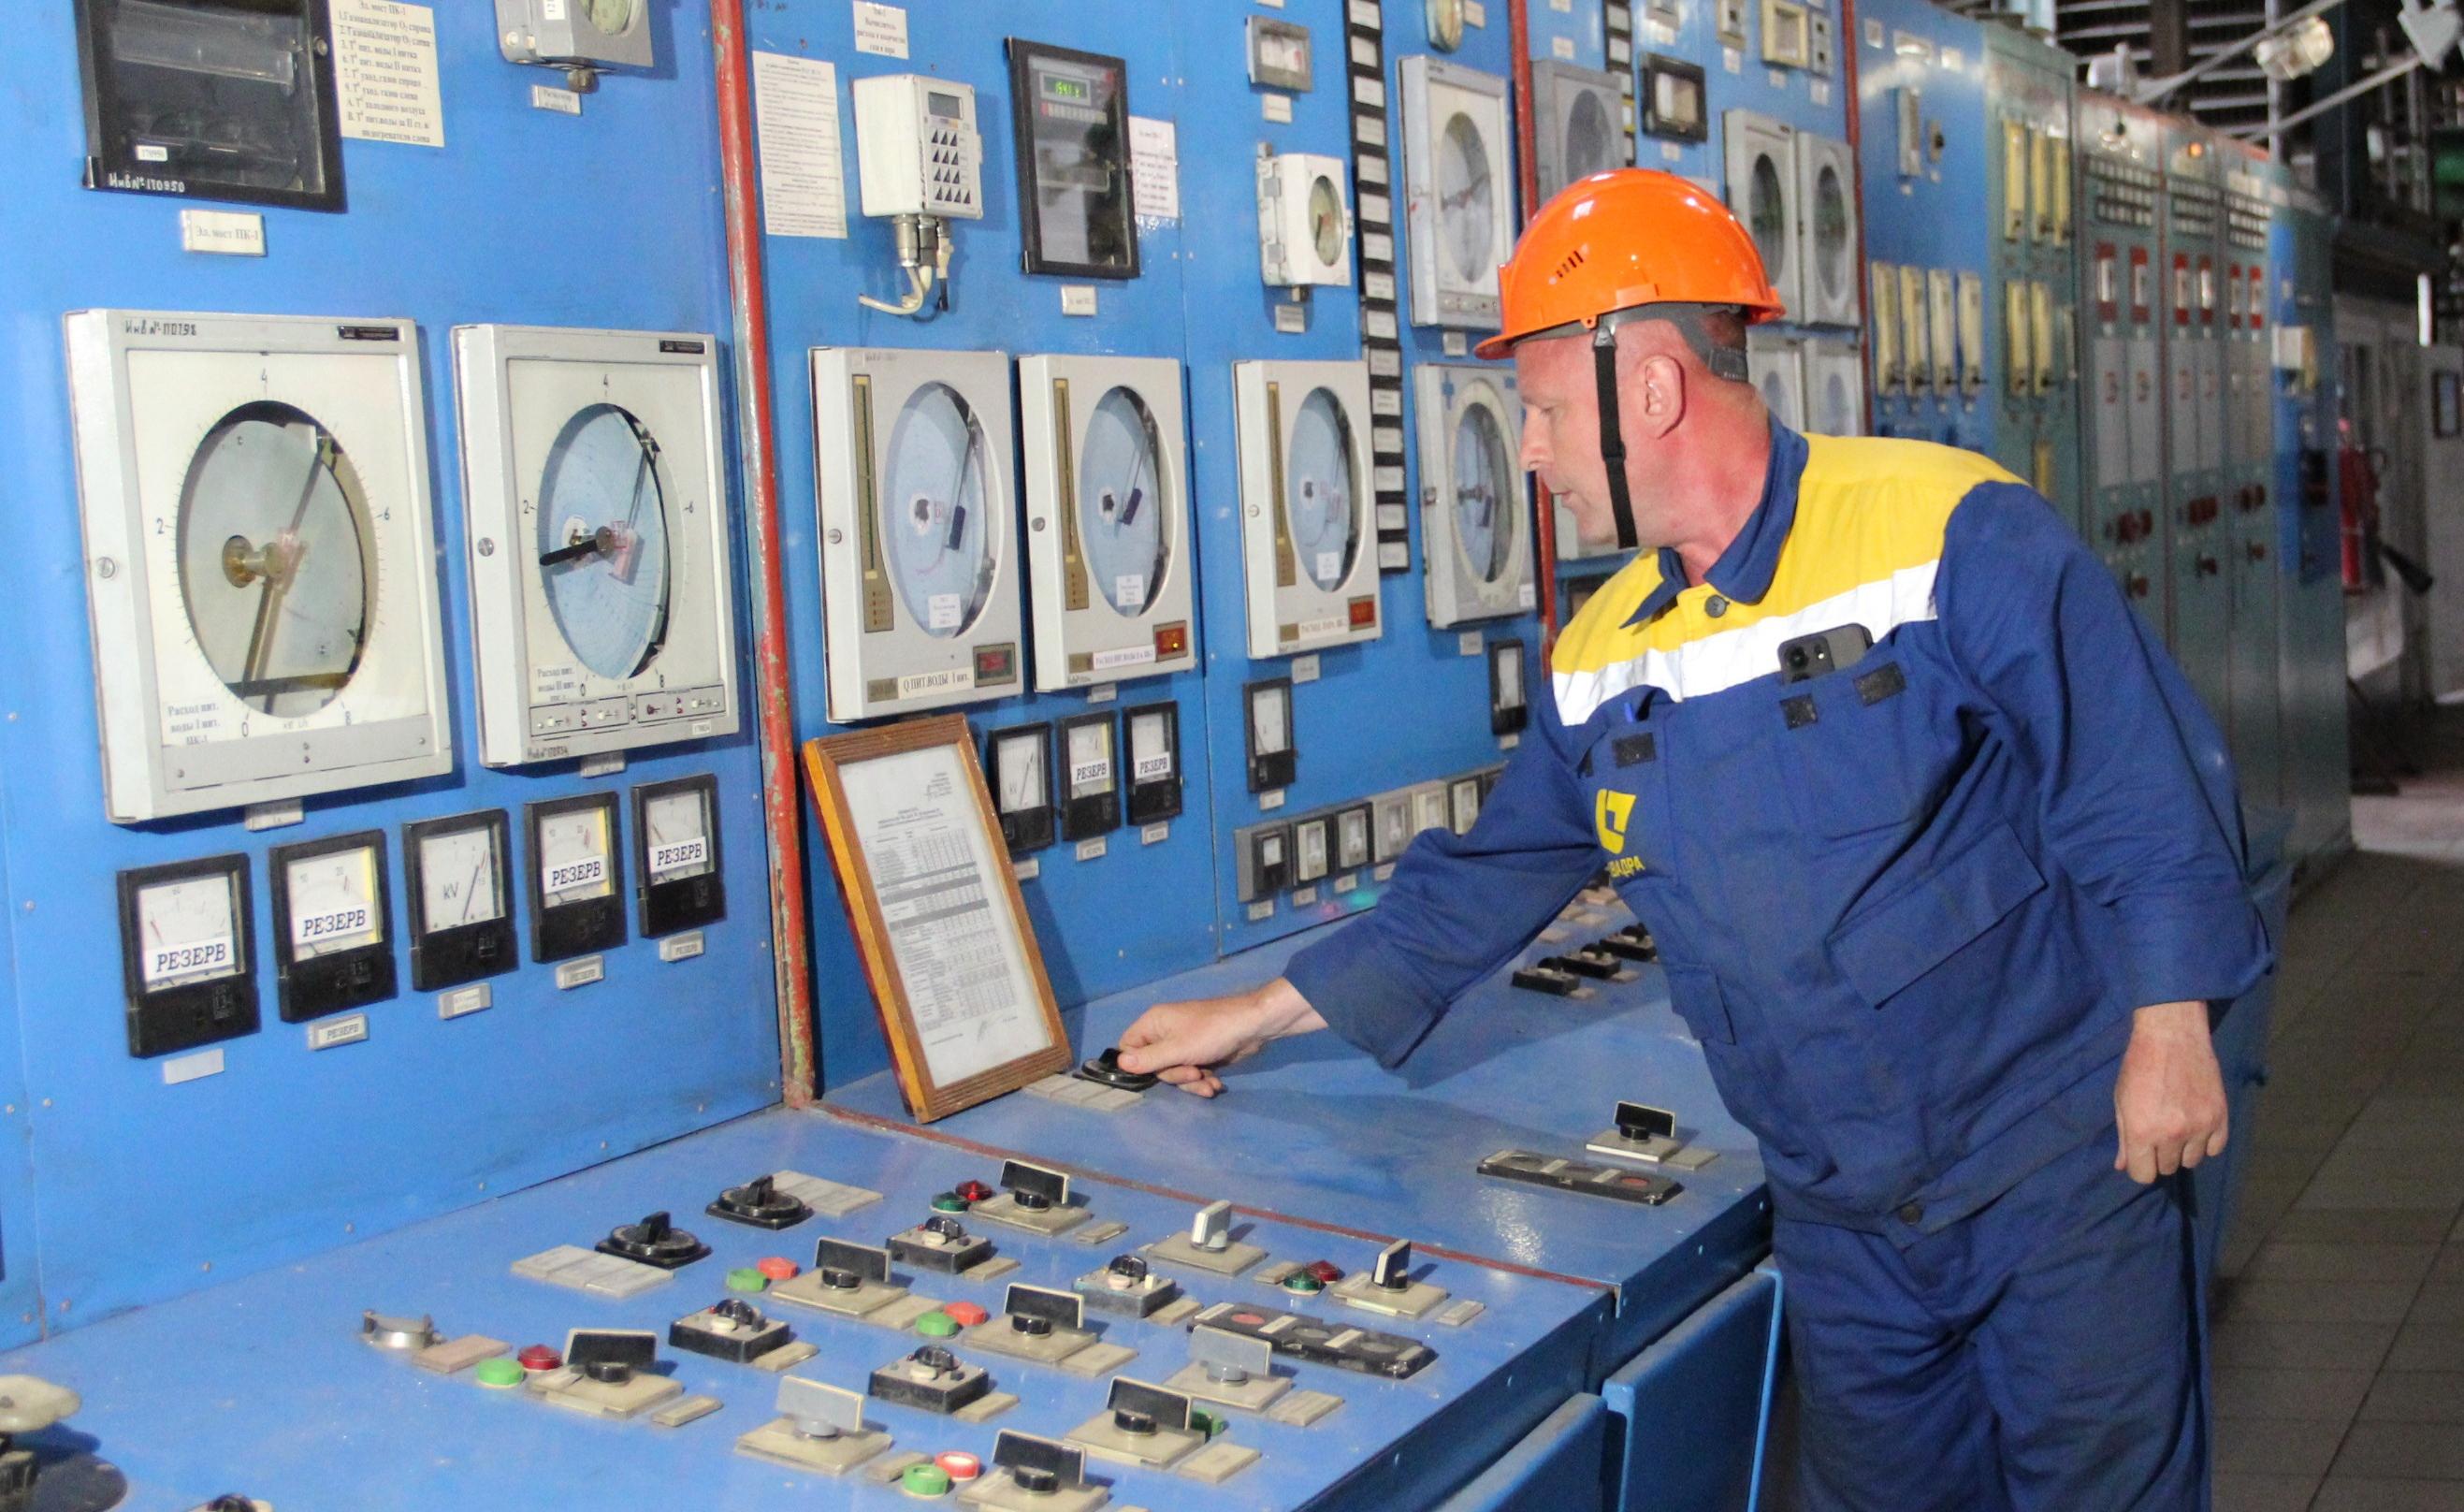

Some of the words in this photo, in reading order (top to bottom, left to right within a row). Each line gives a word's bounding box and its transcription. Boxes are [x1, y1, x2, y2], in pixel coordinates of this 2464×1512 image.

[523, 499, 530, 515] 2
[156, 517, 166, 535] 2
[1076, 763, 1108, 781] РЕЗЕРВ
[1139, 756, 1167, 775] РЕЗЕРВ
[657, 843, 703, 866] РЕЗЕРВ
[551, 861, 601, 887] РЕЗЕРВ
[303, 909, 366, 938] РЕЗЕРВ
[156, 942, 227, 973] РЕЗЕРВ
[327, 1023, 360, 1040] РЕЗЕРВ
